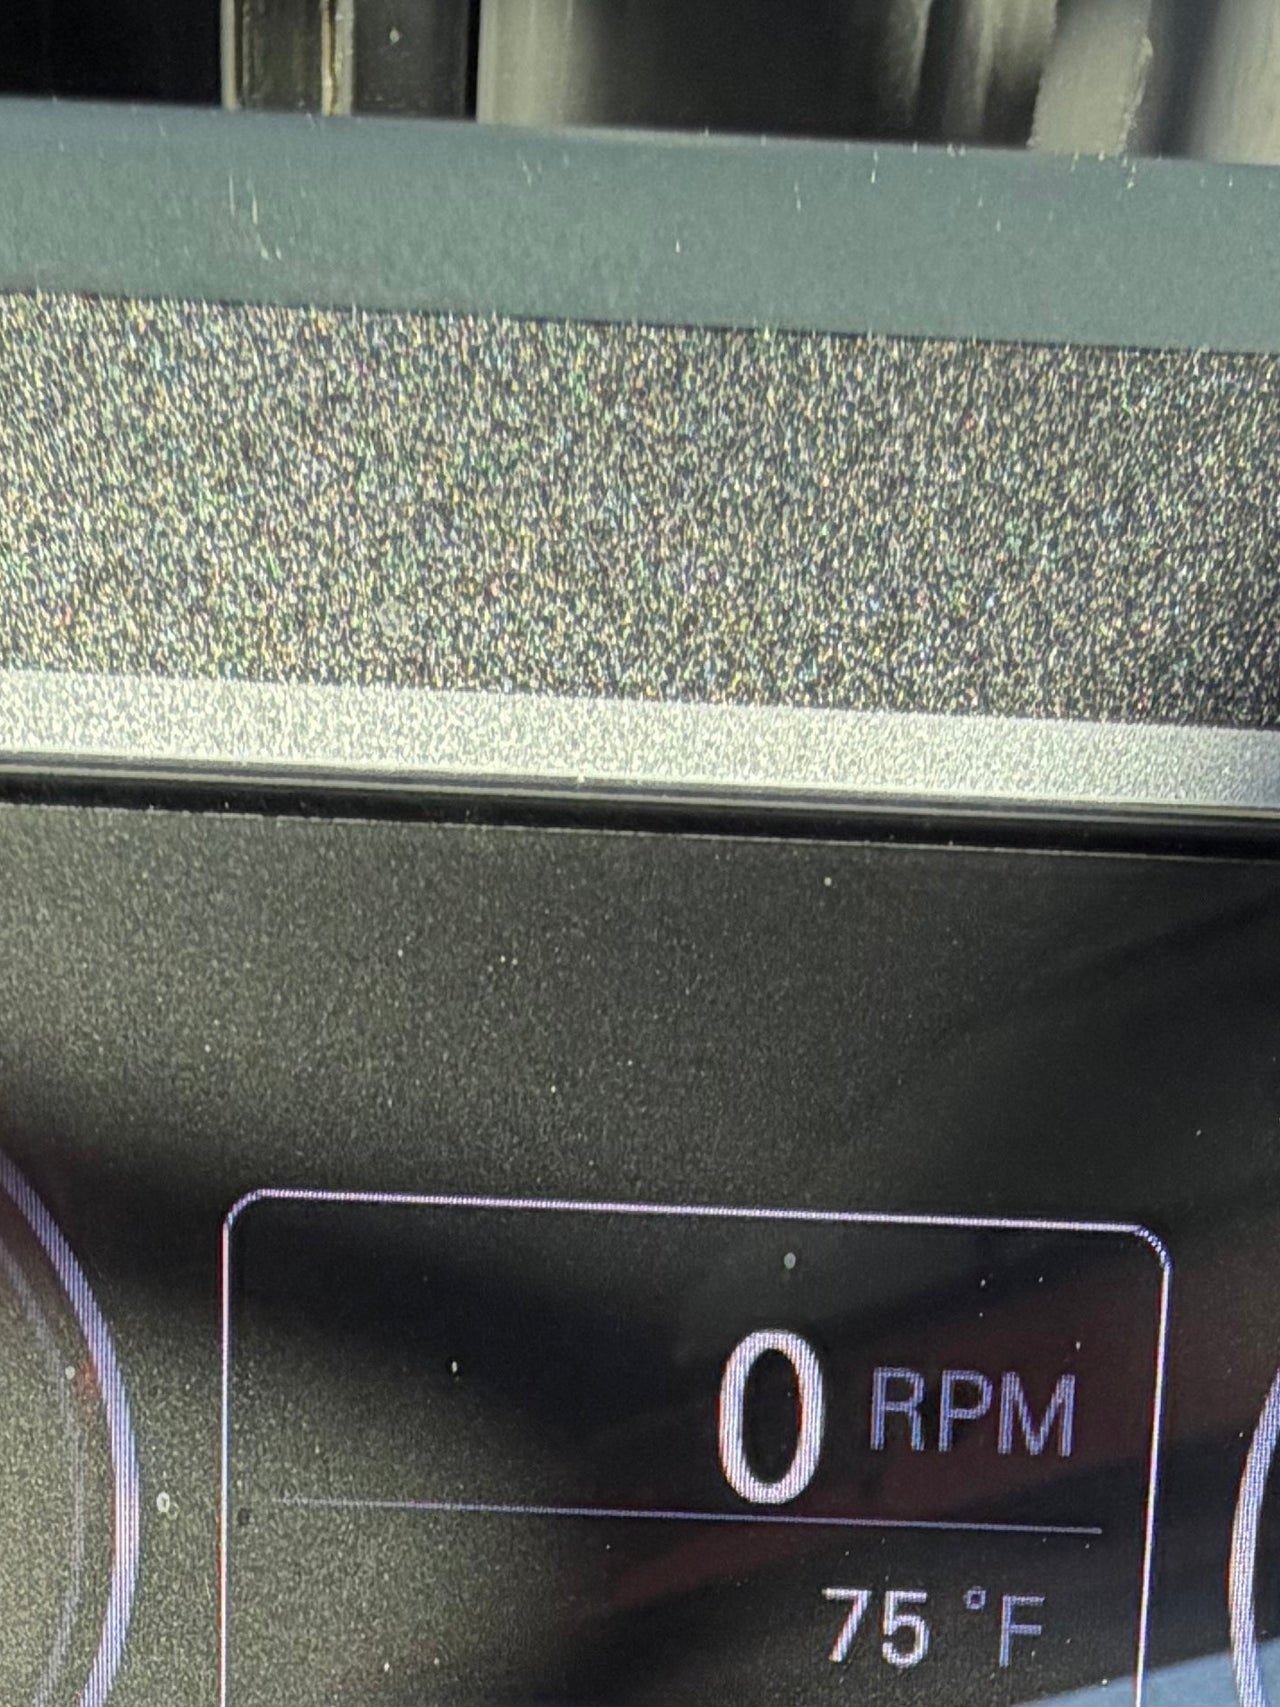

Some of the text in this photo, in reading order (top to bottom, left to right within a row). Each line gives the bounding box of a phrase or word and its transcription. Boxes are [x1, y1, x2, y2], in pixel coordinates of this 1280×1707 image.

[718, 1328, 1077, 1506] 0 RPM
[820, 1587, 930, 1667] 75
